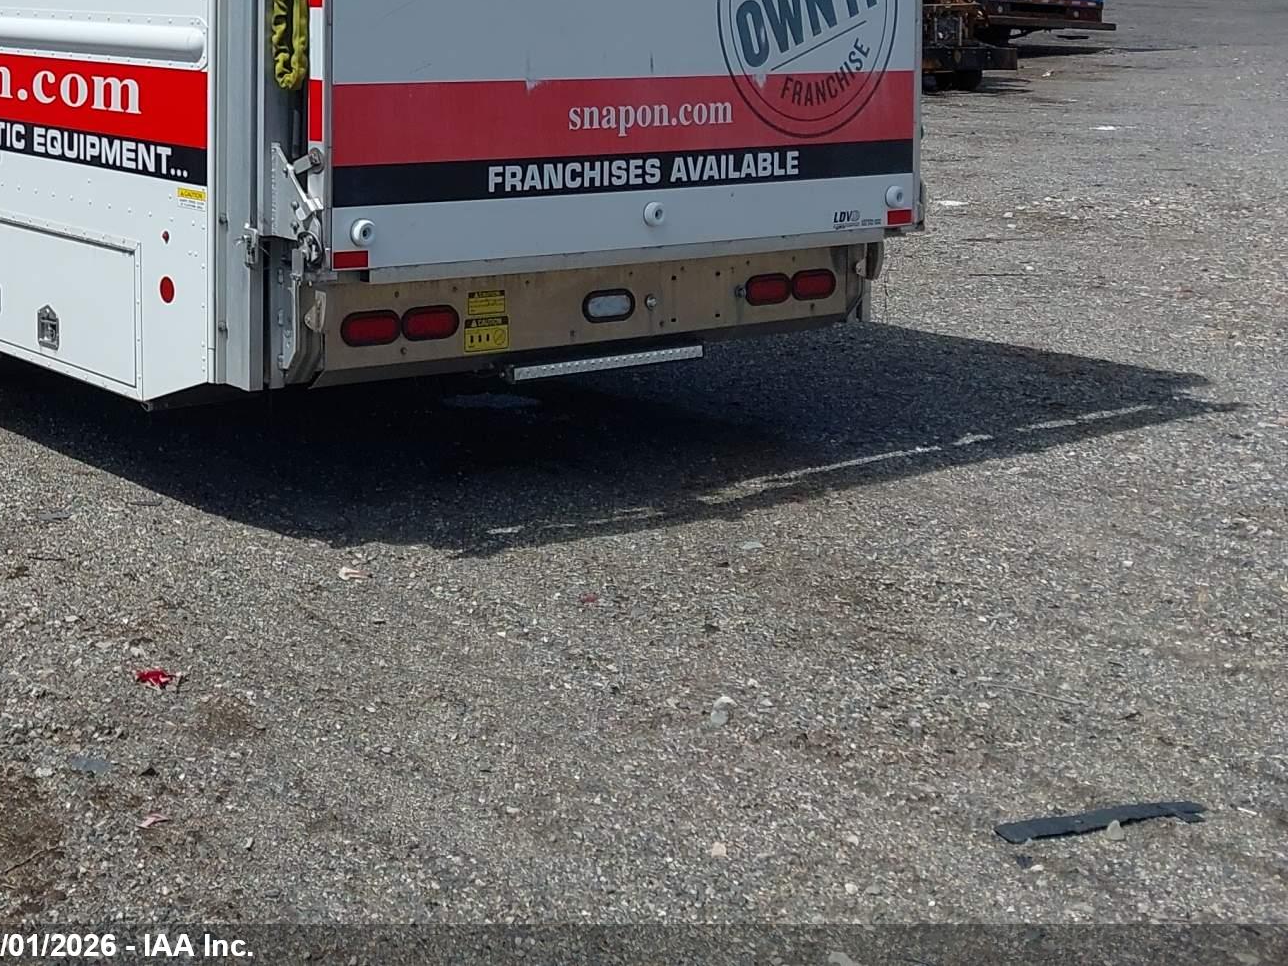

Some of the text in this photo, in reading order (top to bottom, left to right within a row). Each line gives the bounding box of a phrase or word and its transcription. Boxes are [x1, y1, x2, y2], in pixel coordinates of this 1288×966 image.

[781, 38, 870, 106] FRANCHISE
[568, 101, 733, 137] snapon.com
[33, 128, 189, 179] EQUIPMENT...
[488, 151, 800, 193] FRANCHISES AVAILABLE
